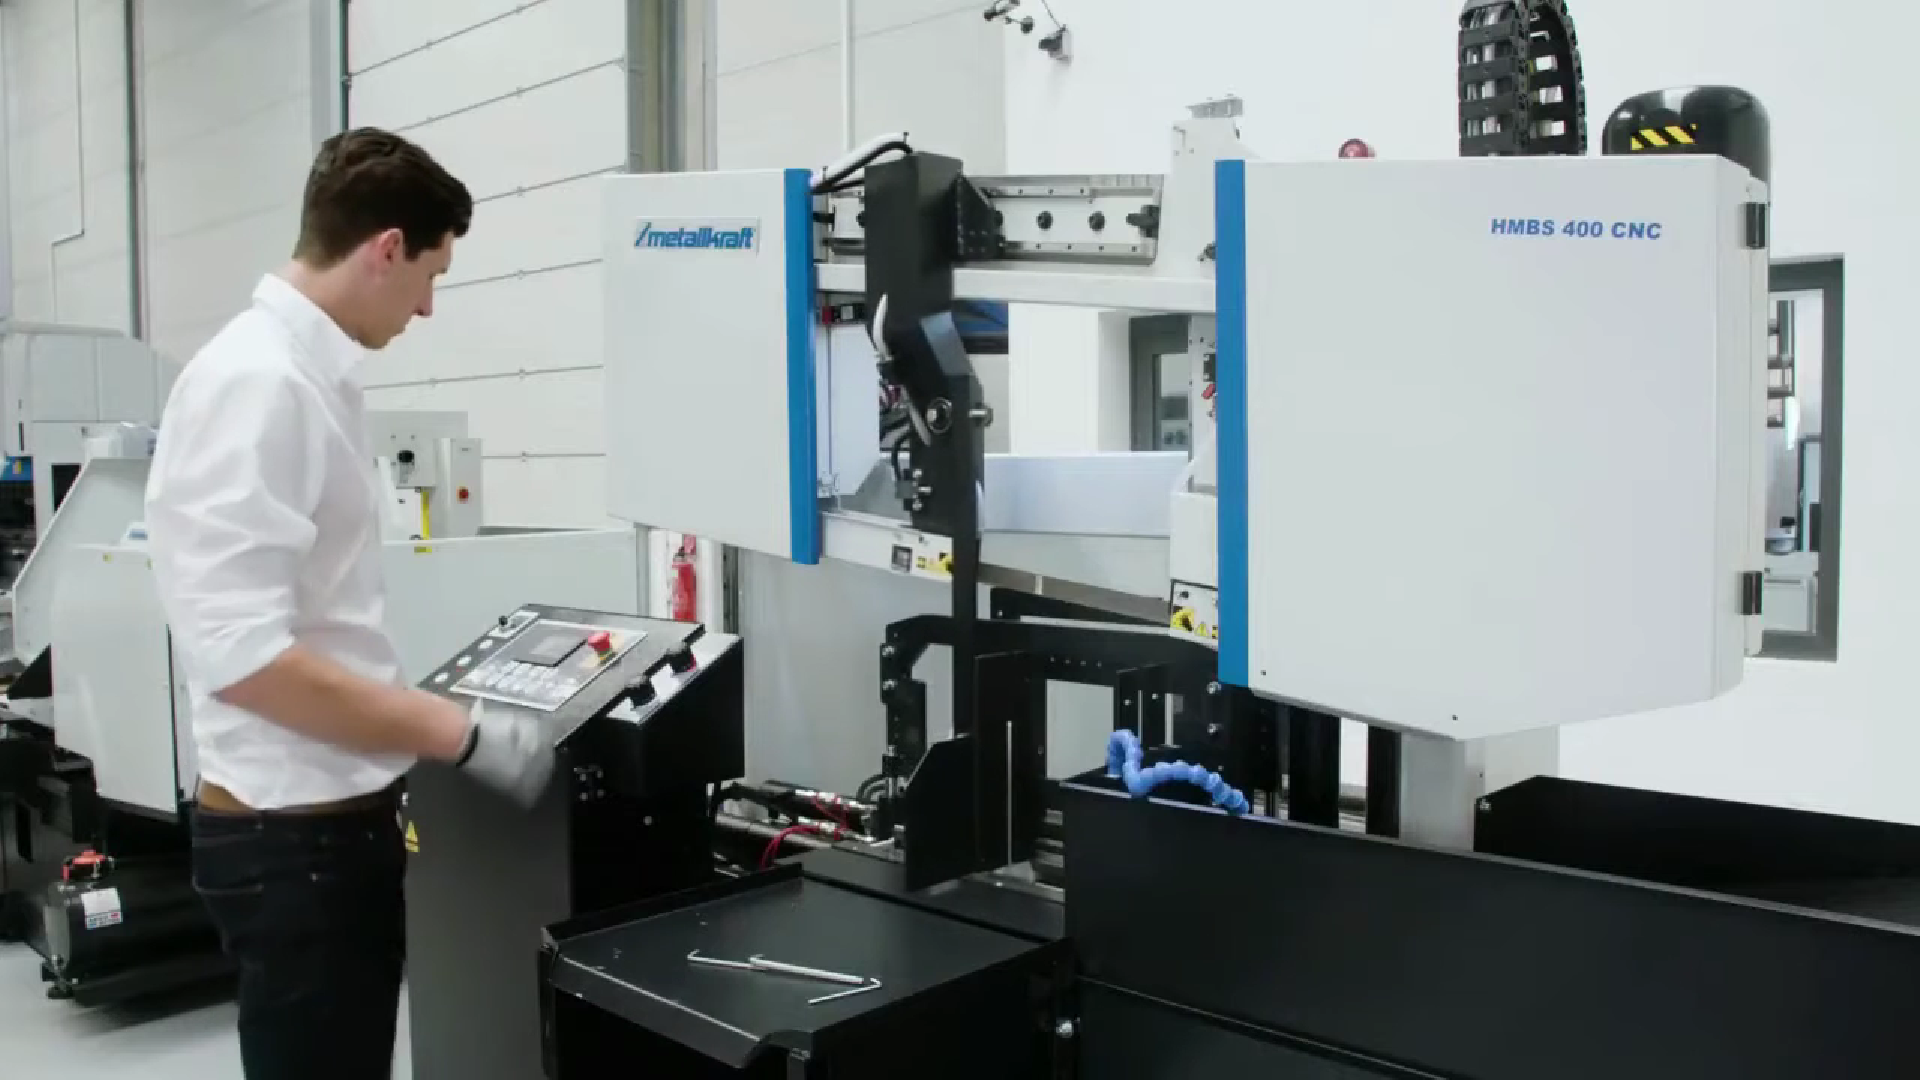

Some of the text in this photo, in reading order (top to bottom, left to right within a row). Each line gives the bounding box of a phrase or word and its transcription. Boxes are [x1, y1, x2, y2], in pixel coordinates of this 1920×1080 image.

[647, 227, 754, 249] metallkraft
[1491, 219, 1662, 240] HMBS 400 CNC
